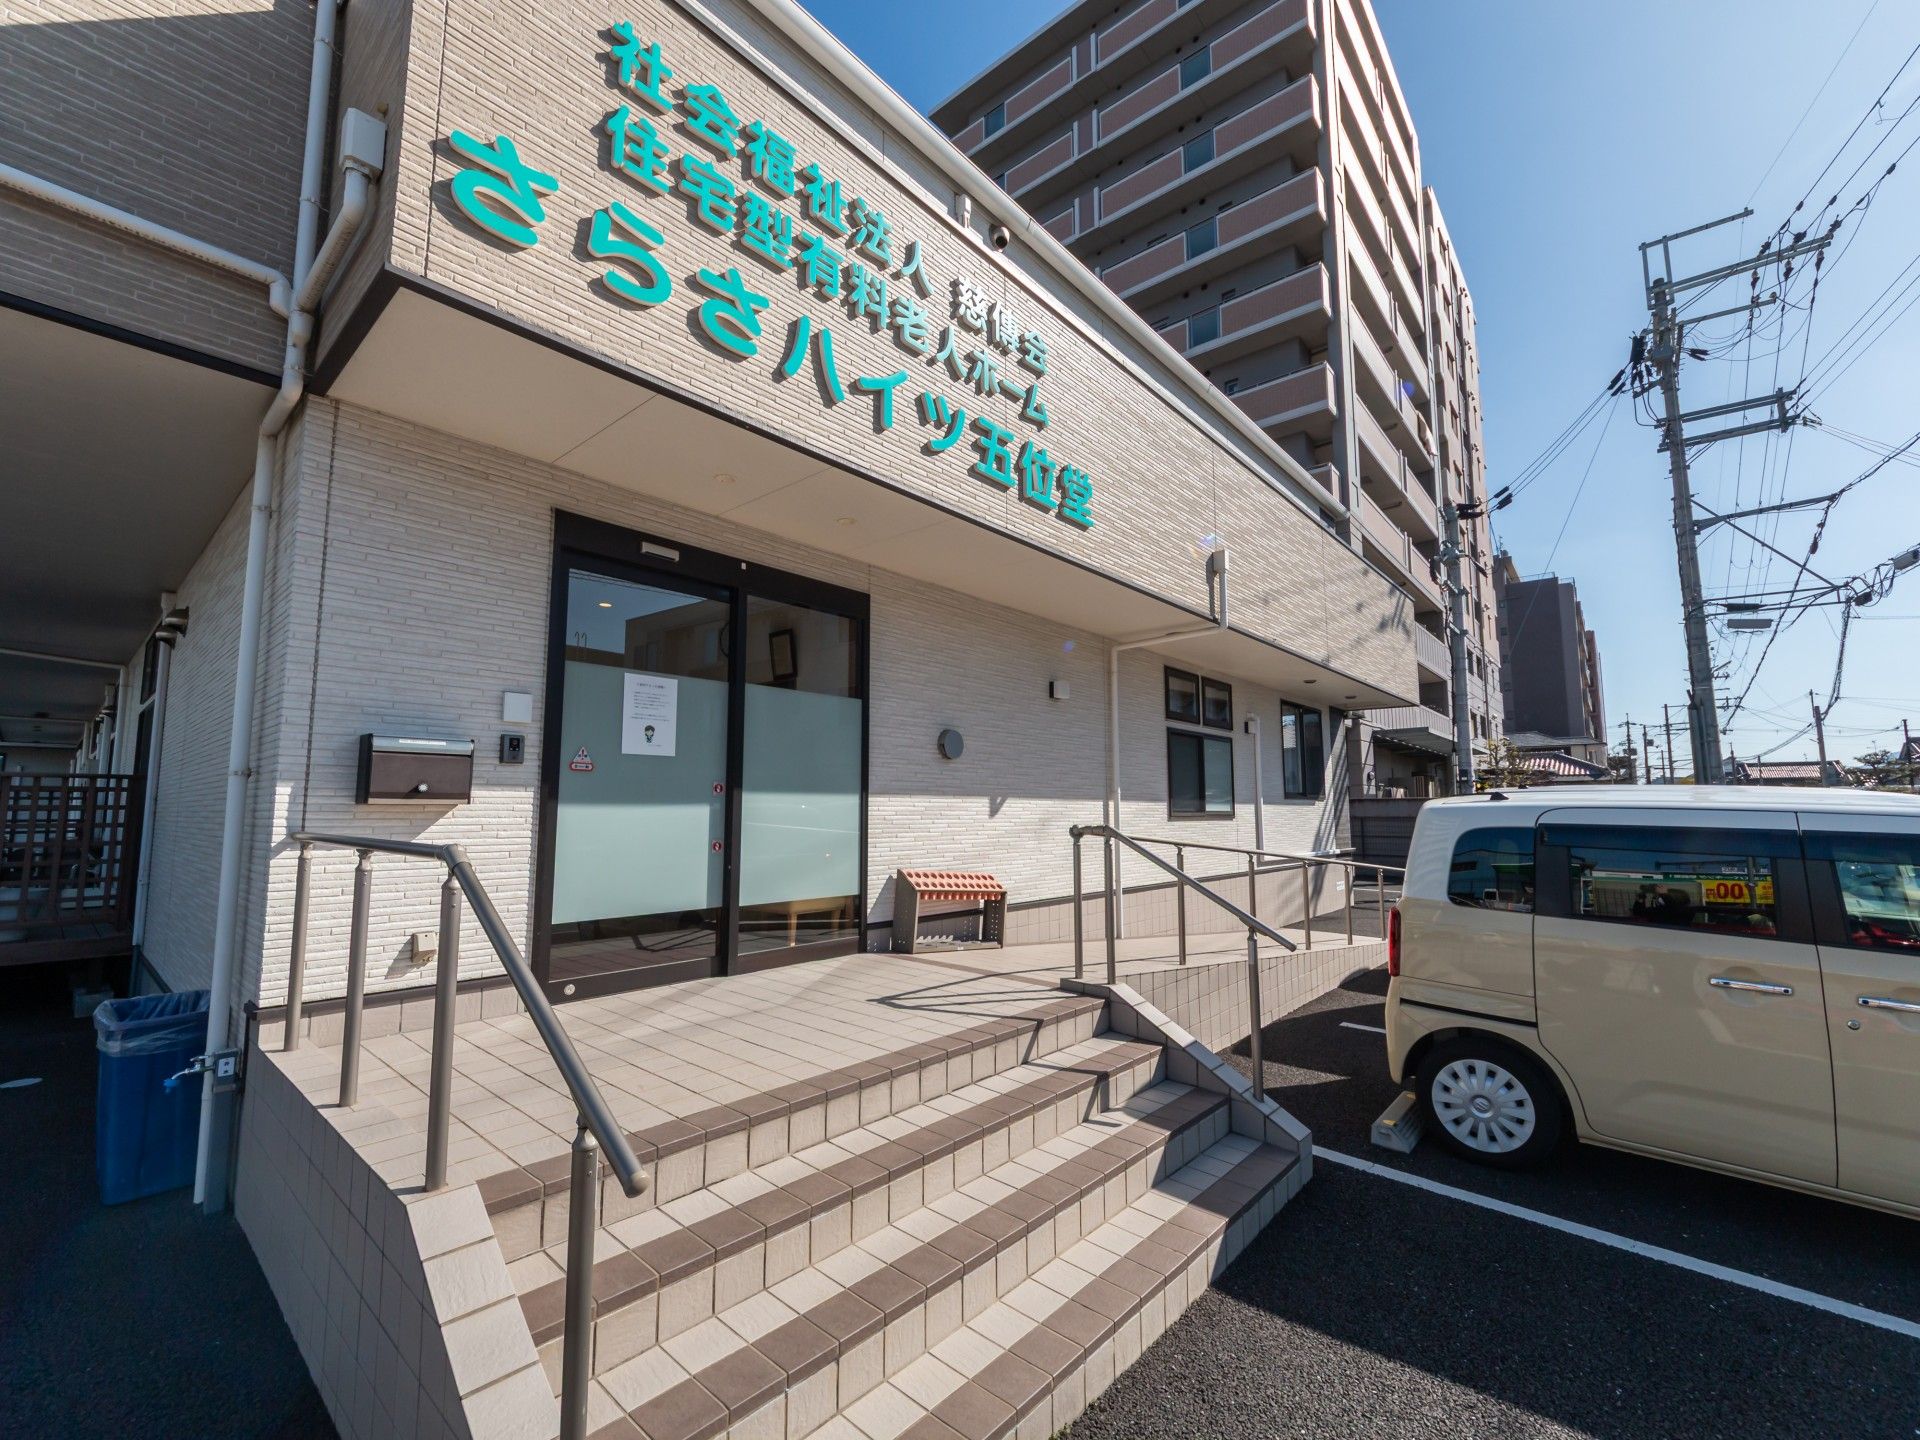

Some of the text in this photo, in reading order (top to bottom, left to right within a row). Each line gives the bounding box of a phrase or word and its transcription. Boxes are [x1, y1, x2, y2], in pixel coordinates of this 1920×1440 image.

[605, 103, 1050, 428] 住宅型有料老人ホーム
[609, 20, 934, 298] 社会福祉法人
[449, 129, 1096, 528] さらさハイツ五位堂
